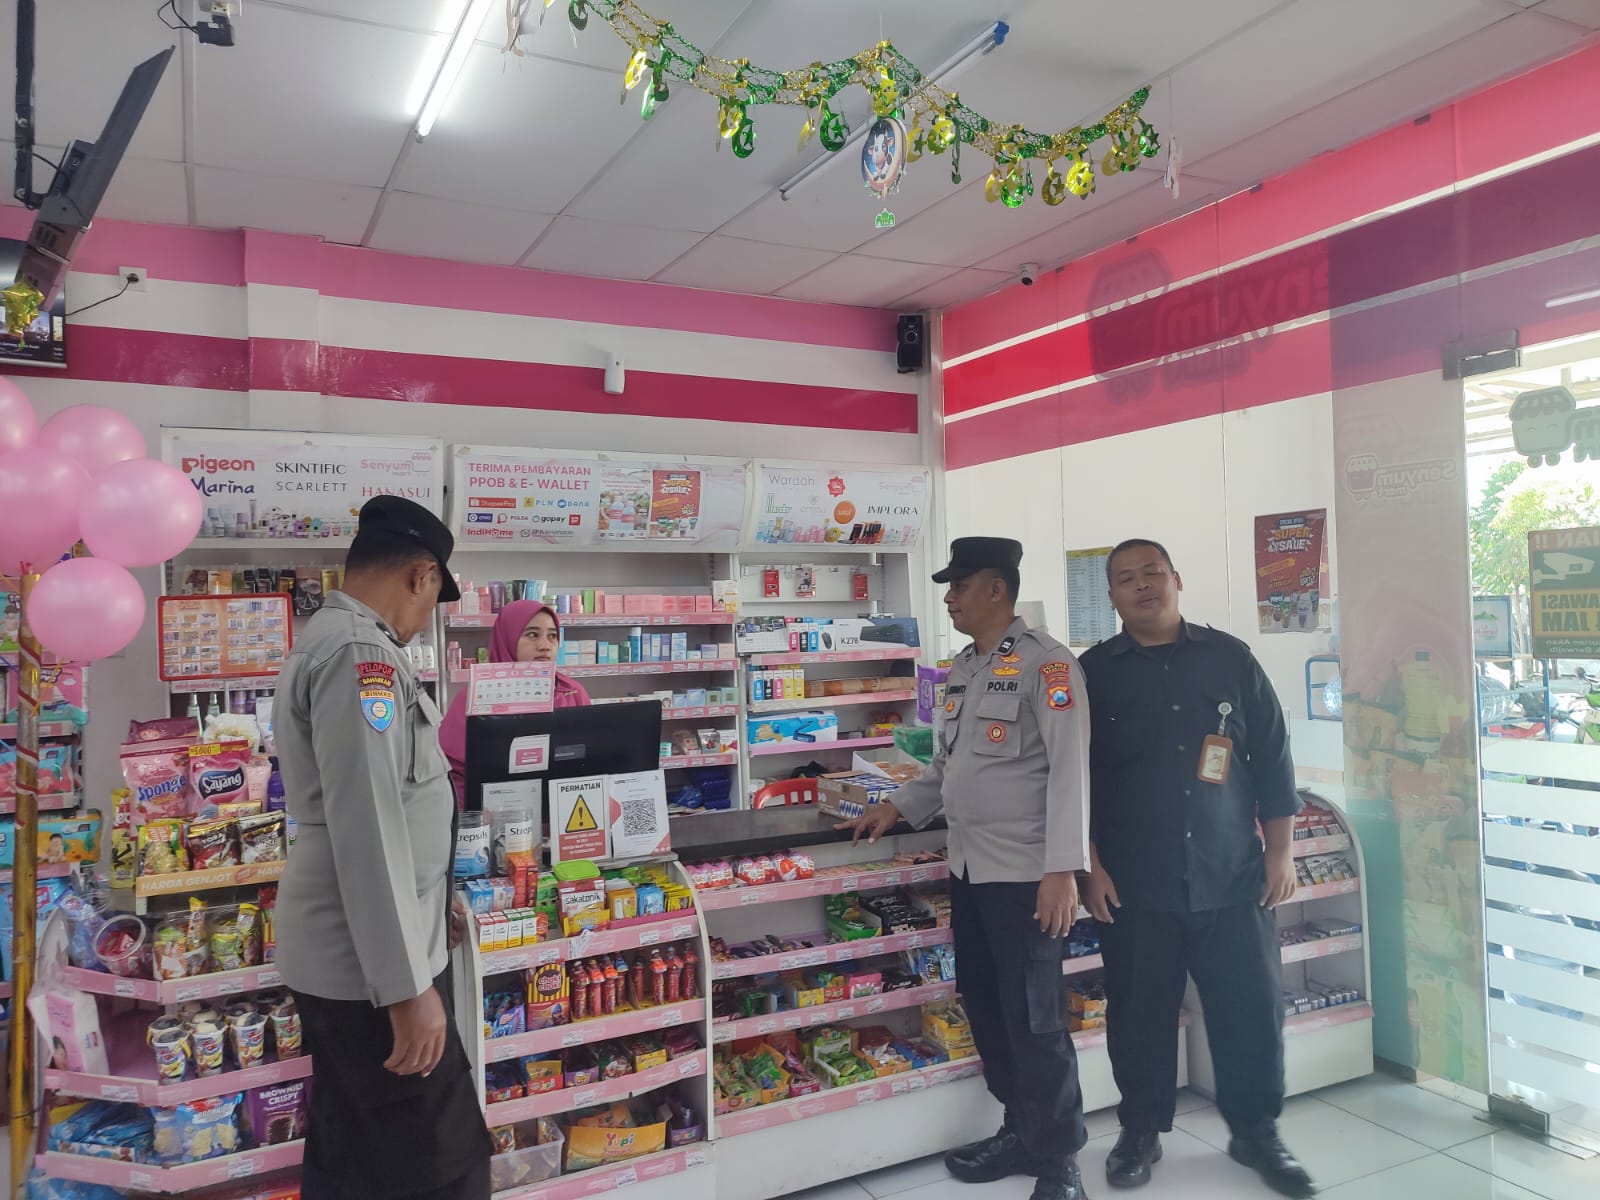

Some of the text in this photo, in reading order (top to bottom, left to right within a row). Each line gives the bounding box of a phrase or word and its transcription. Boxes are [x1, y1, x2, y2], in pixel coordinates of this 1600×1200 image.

[181, 454, 255, 474] pigeon
[274, 462, 347, 475] SKINTIFIC
[360, 459, 412, 473] Senyum
[468, 463, 591, 476] TERIMA PEMBAYARAN
[190, 476, 255, 497] Marina
[276, 481, 348, 493] SCARLETT
[469, 477, 505, 488] PPOB
[508, 478, 517, 488] &
[537, 479, 590, 491] WALLET
[361, 486, 431, 499] HANASUI
[867, 504, 919, 516] IMPLORA
[540, 515, 566, 524] gopay
[1275, 527, 1310, 540] SUPER
[986, 681, 1018, 692] POLRI
[138, 775, 187, 803] Sponge
[201, 773, 242, 794] Sayang
[560, 782, 601, 793] PERHATIAN
[141, 877, 184, 891] HARGA
[184, 871, 233, 887] GENJOT
[259, 1083, 304, 1100] BROWNIES
[268, 1092, 298, 1105] CRISPY
[606, 1132, 635, 1147] Yupi
